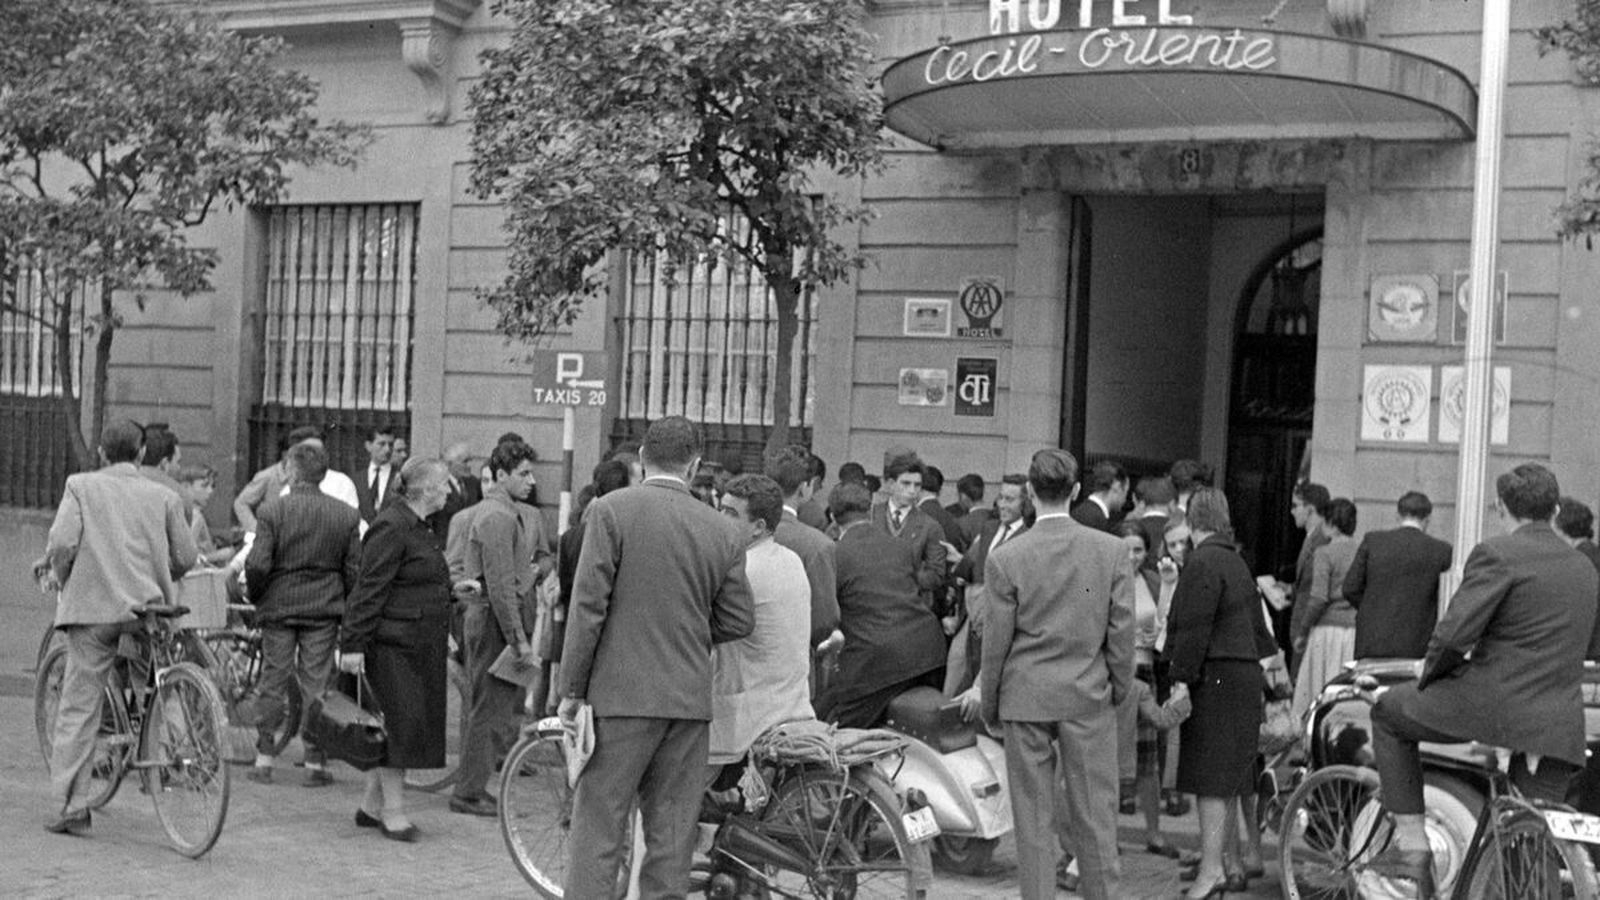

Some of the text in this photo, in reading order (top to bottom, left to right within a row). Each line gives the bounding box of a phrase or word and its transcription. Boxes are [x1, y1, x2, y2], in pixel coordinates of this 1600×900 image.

[990, 0, 1193, 34] HOTEL
[556, 353, 583, 383] P
[534, 387, 607, 406] TAXIS 20
